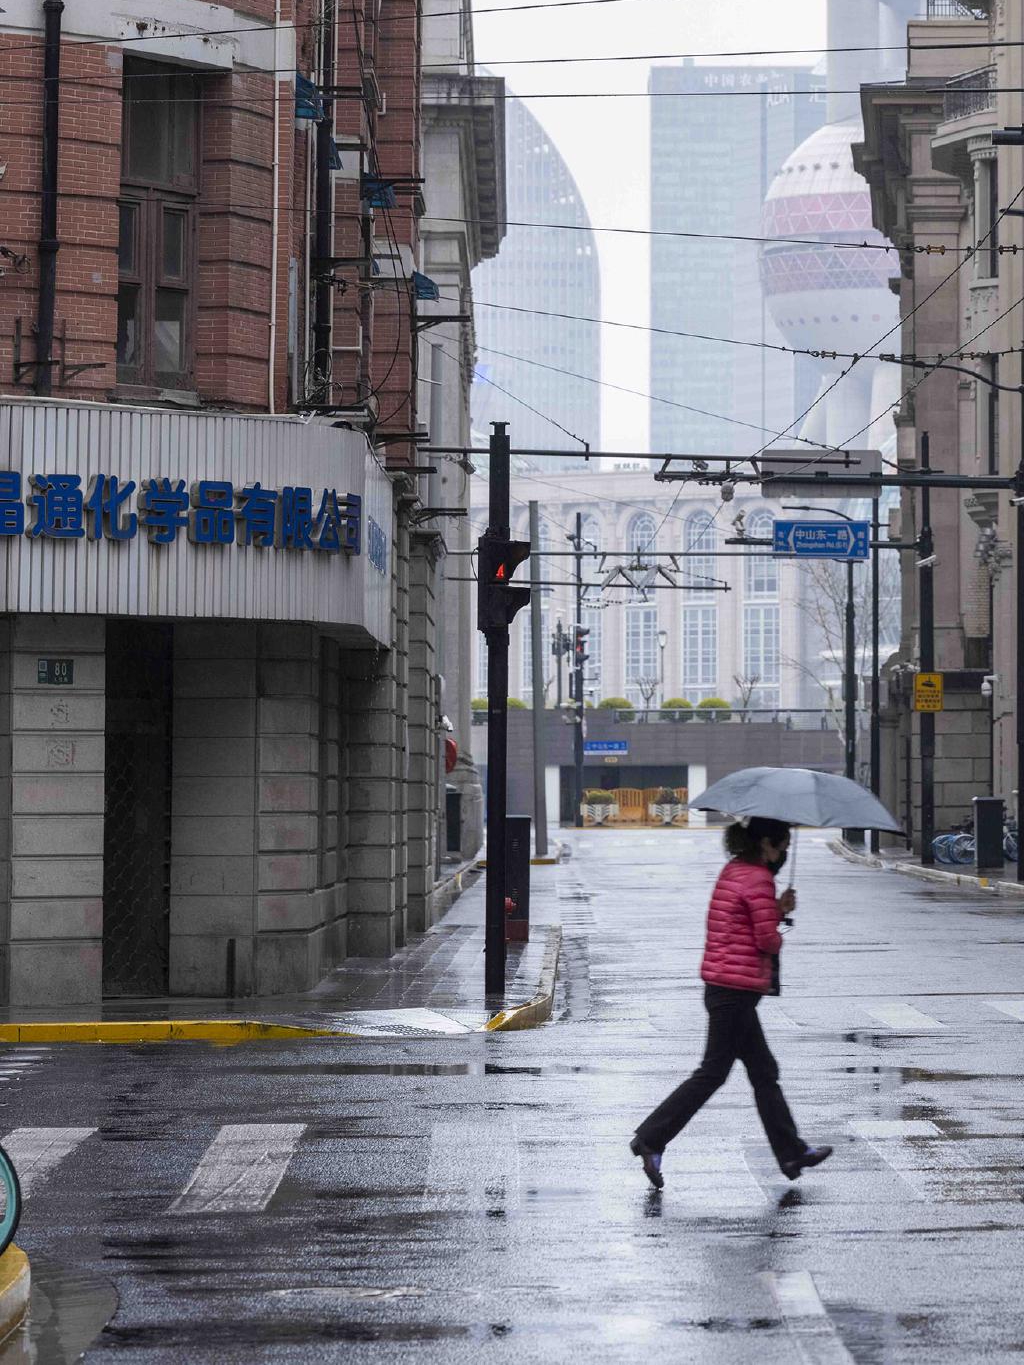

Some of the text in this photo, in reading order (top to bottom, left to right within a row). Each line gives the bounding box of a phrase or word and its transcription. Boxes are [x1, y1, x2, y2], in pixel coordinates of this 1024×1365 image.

[795, 529, 848, 540] 中山东一路
[54, 662, 67, 676] 80
